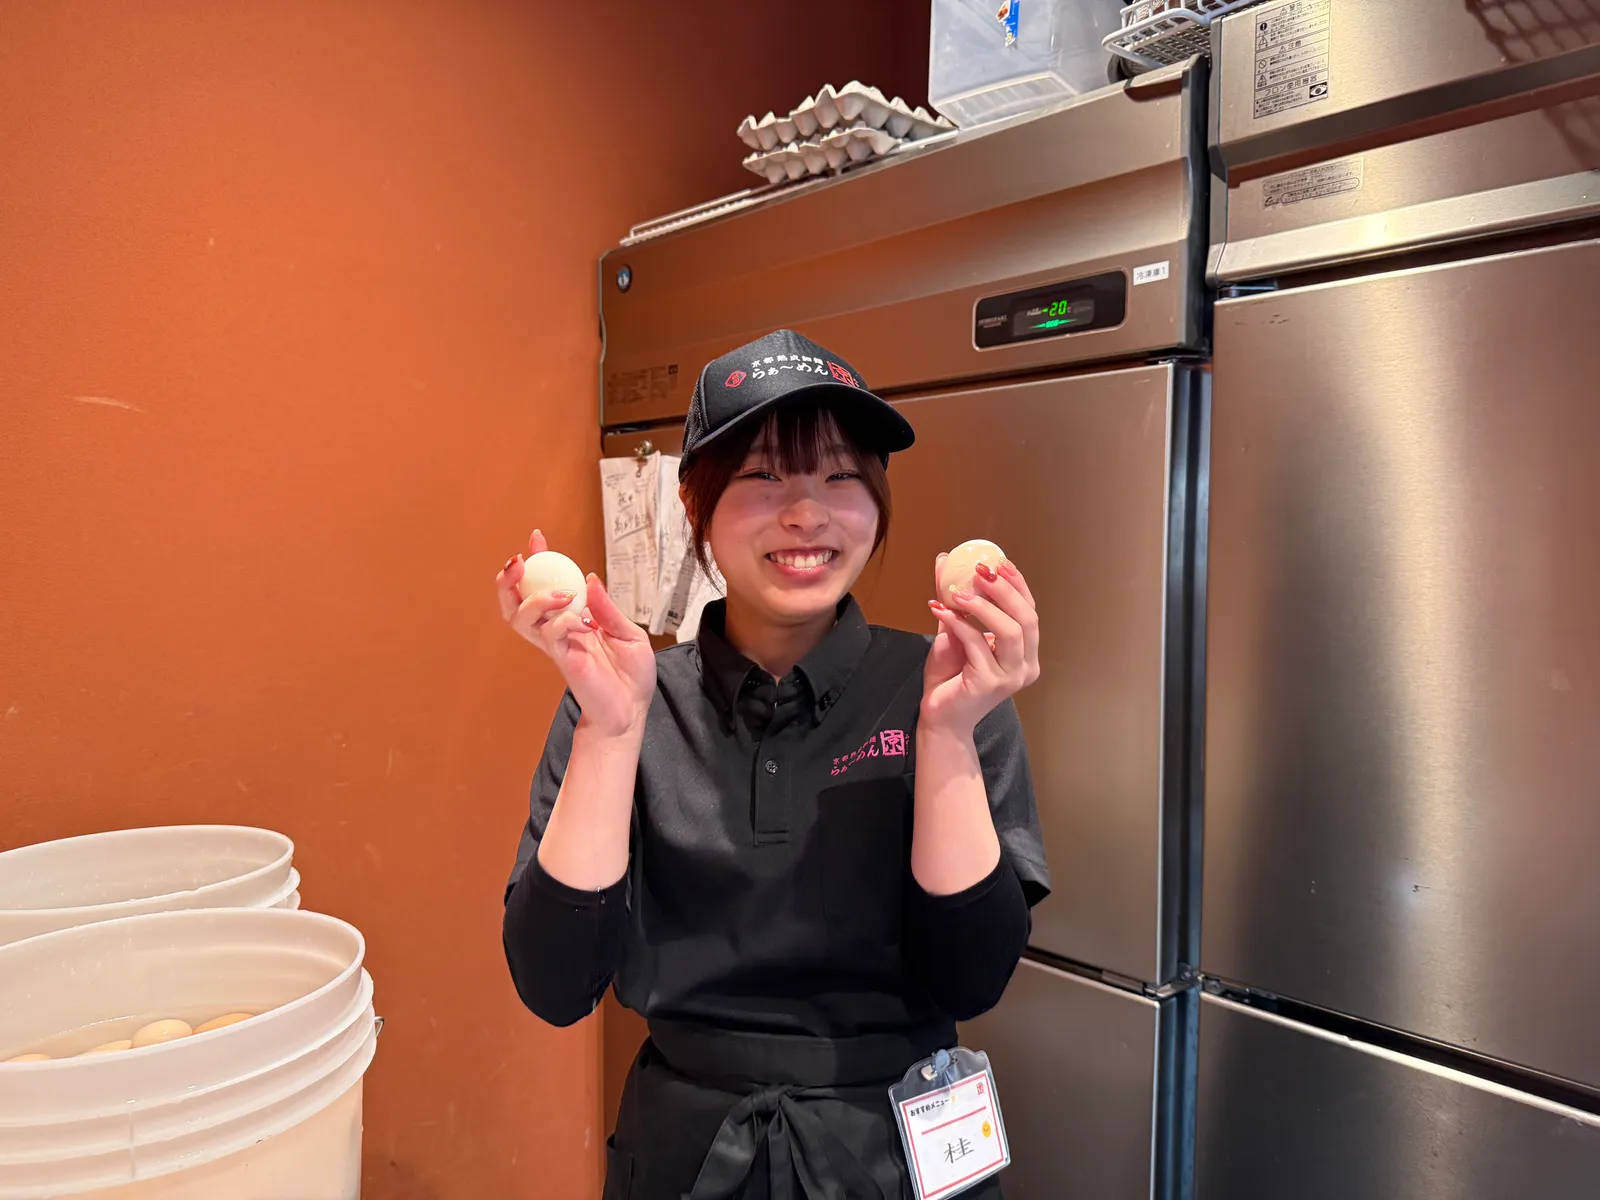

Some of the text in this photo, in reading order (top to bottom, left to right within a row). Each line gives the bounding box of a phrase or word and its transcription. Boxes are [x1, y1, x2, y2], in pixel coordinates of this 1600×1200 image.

[1136, 266, 1167, 281] 冷凍庫1
[910, 1098, 950, 1117] おすすめメニュー
[944, 1137, 974, 1164] 桂
